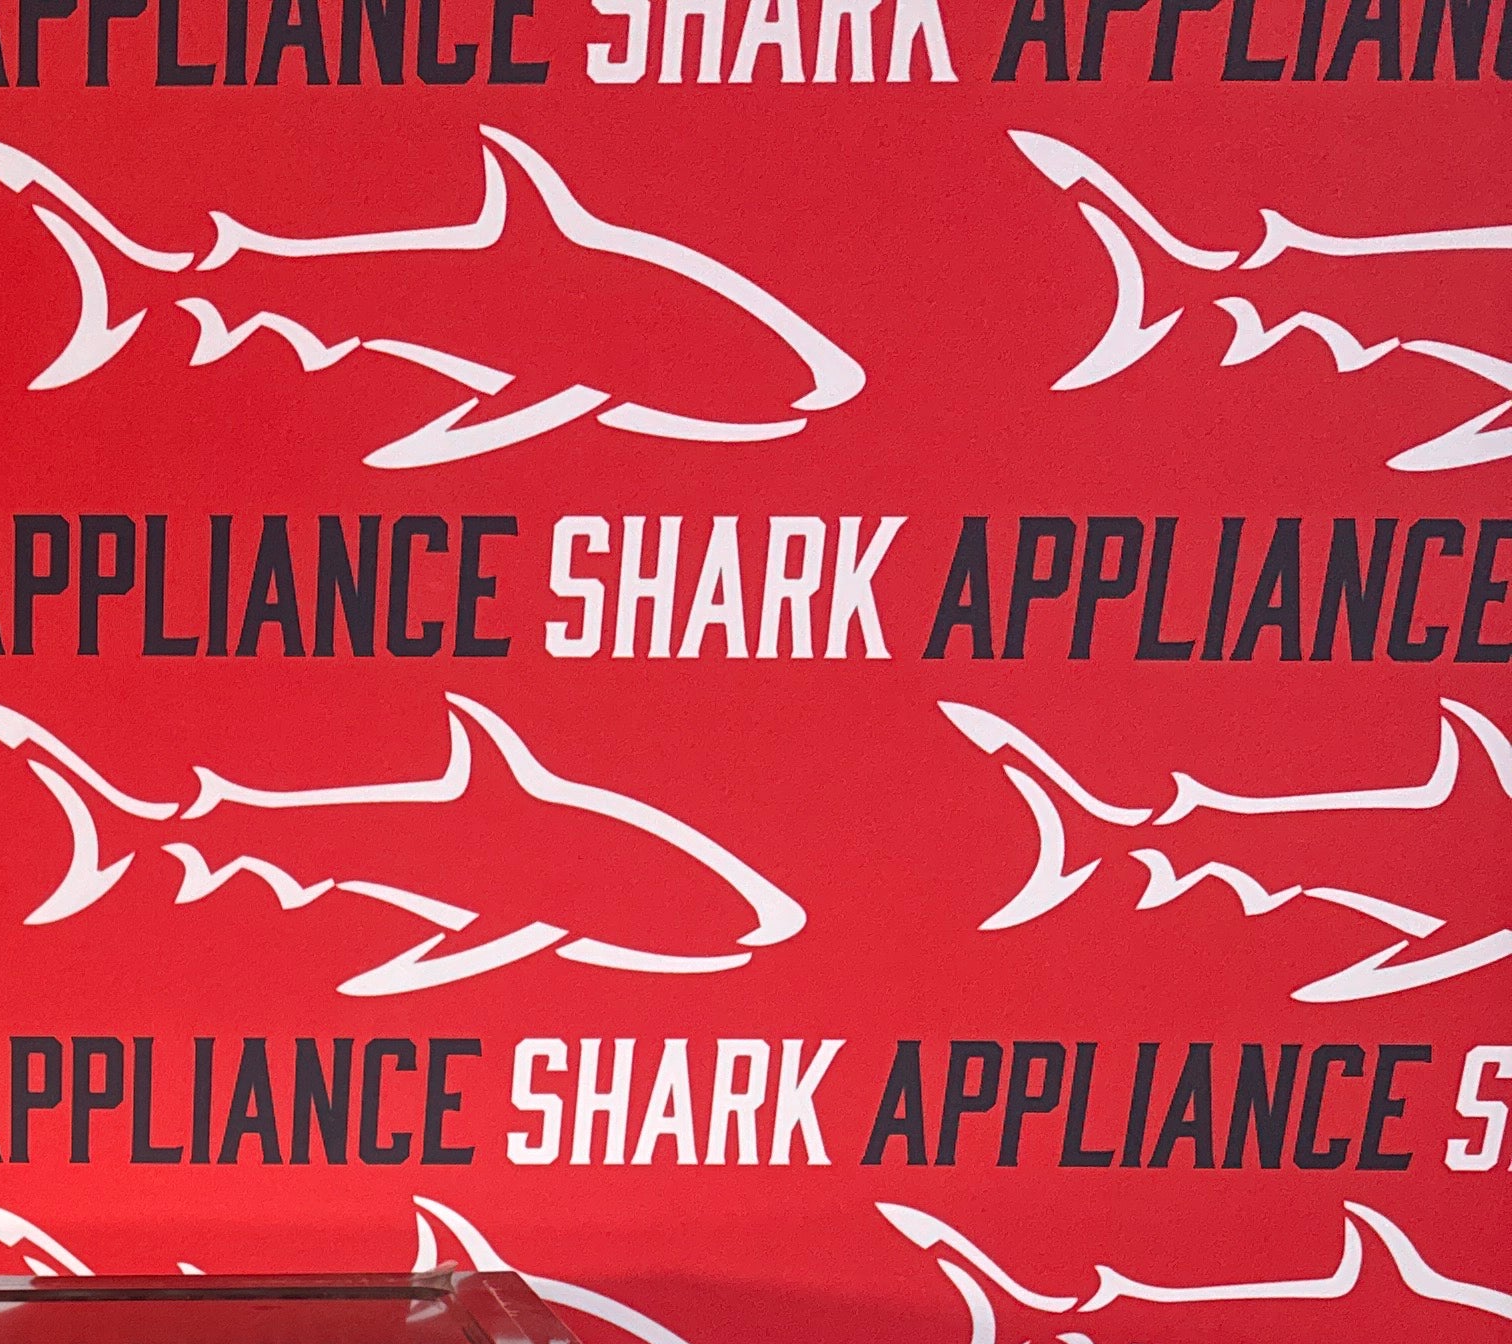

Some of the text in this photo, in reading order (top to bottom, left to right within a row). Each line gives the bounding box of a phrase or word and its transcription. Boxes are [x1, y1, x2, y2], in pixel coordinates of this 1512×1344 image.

[587, 0, 958, 83] SHARK
[993, 0, 1512, 81] APPLIAN
[546, 516, 907, 658] SHARK
[924, 517, 1512, 662] APPLIANCE
[507, 1038, 845, 1165] SHARK
[863, 1041, 1431, 1170] APPLIANCE
